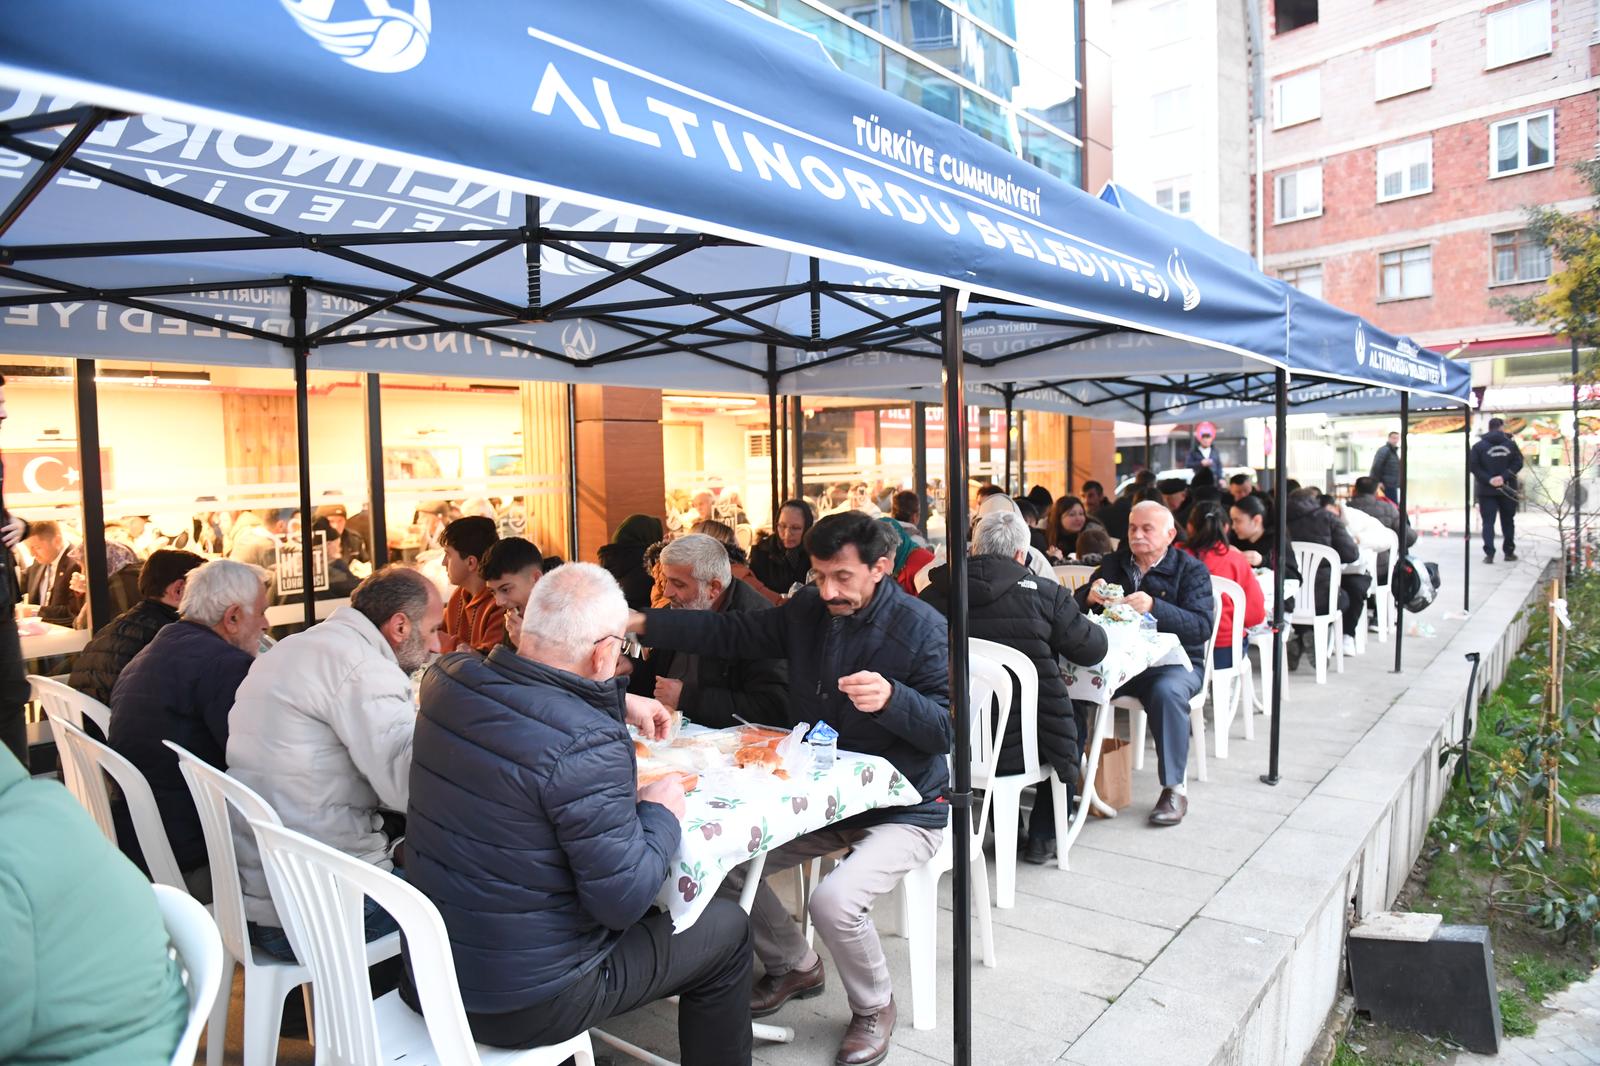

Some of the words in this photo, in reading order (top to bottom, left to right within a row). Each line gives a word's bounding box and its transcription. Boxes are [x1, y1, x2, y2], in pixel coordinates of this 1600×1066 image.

[531, 62, 960, 236] ALTINORDU
[853, 114, 935, 175] TÜRKİYE
[939, 153, 1041, 217] CUMHURİYETİ
